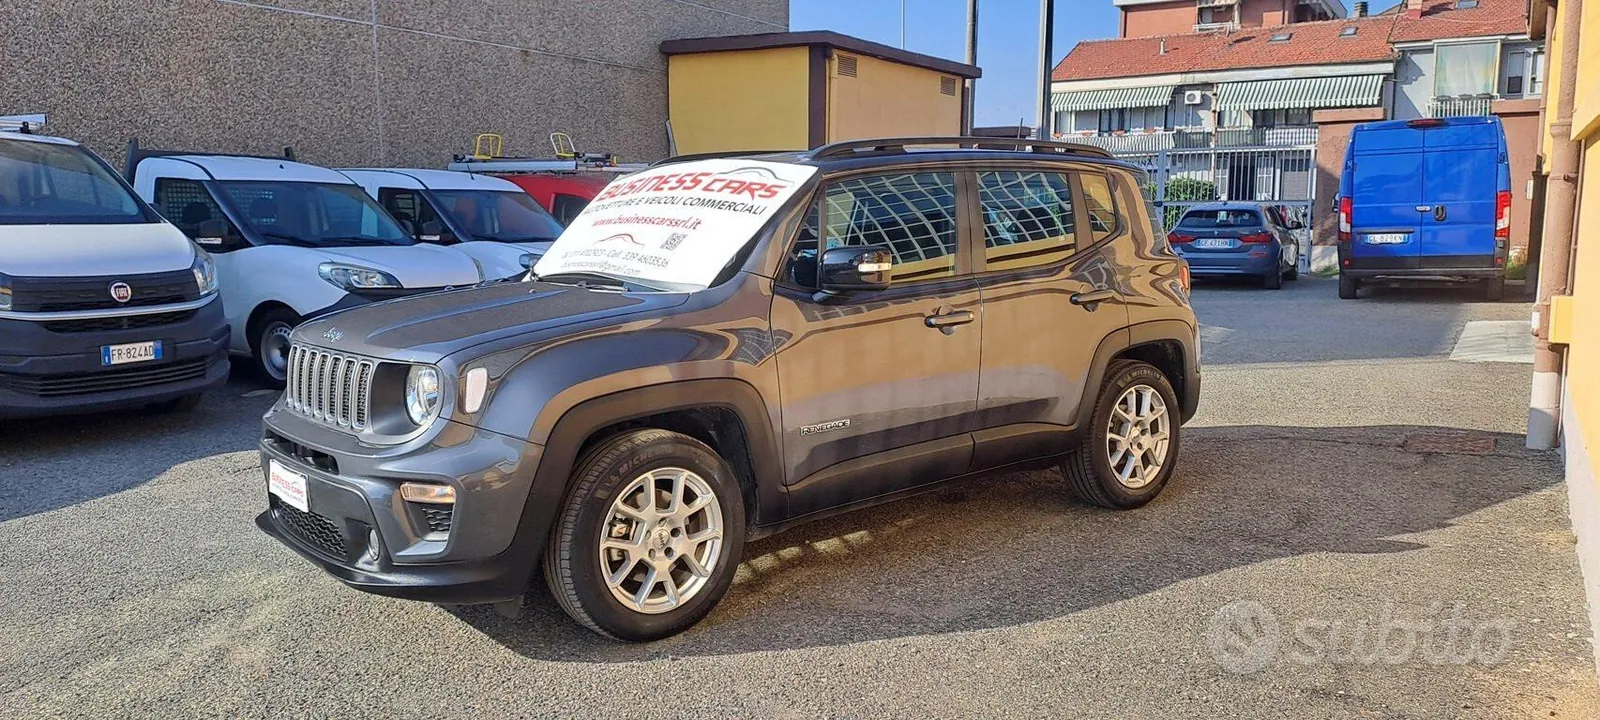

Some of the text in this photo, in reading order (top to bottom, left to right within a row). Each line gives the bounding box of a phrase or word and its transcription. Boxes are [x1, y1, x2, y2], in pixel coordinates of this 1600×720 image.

[597, 172, 787, 202] BUSINESS CARS
[643, 194, 684, 206] VEICOLI
[682, 197, 768, 216] COMMERCIALI
[591, 214, 703, 230] www.businesscarssrl.it
[800, 418, 852, 436] RENEGADE
